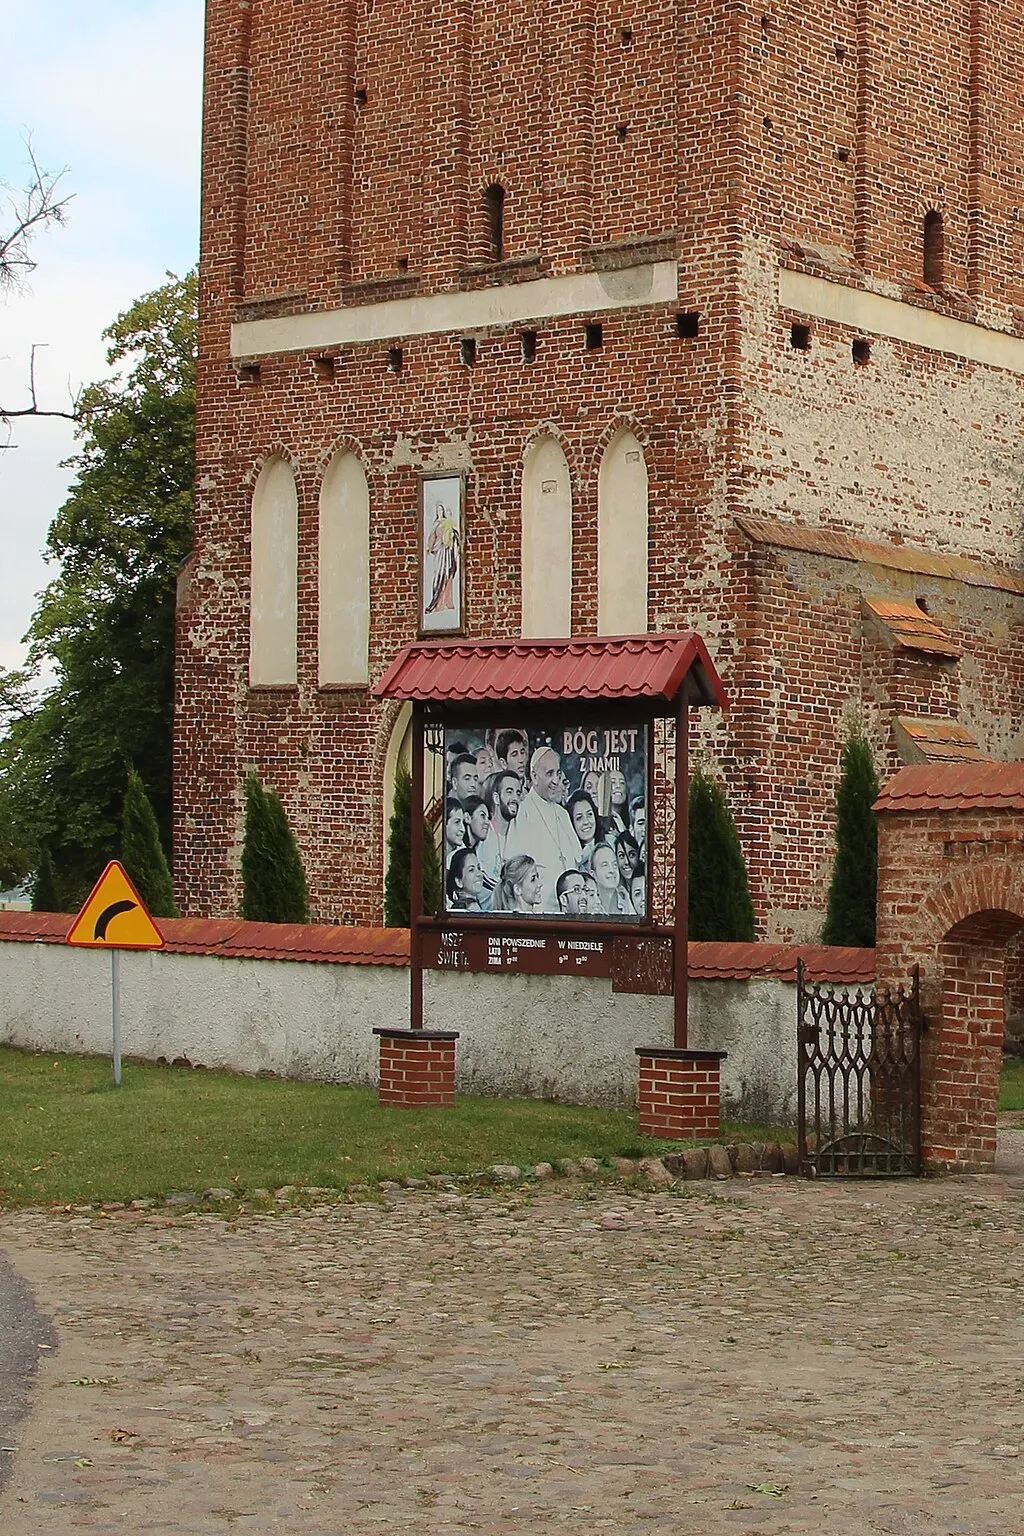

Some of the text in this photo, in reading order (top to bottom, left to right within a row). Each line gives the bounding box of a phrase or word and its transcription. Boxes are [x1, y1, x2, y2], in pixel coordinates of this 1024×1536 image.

[563, 726, 638, 758] BÓG JEST
[580, 756, 620, 772] Z NAMI!
[488, 937, 547, 949] DNI POWSZEDNIE
[557, 940, 604, 954] W NIEDZIELĘ
